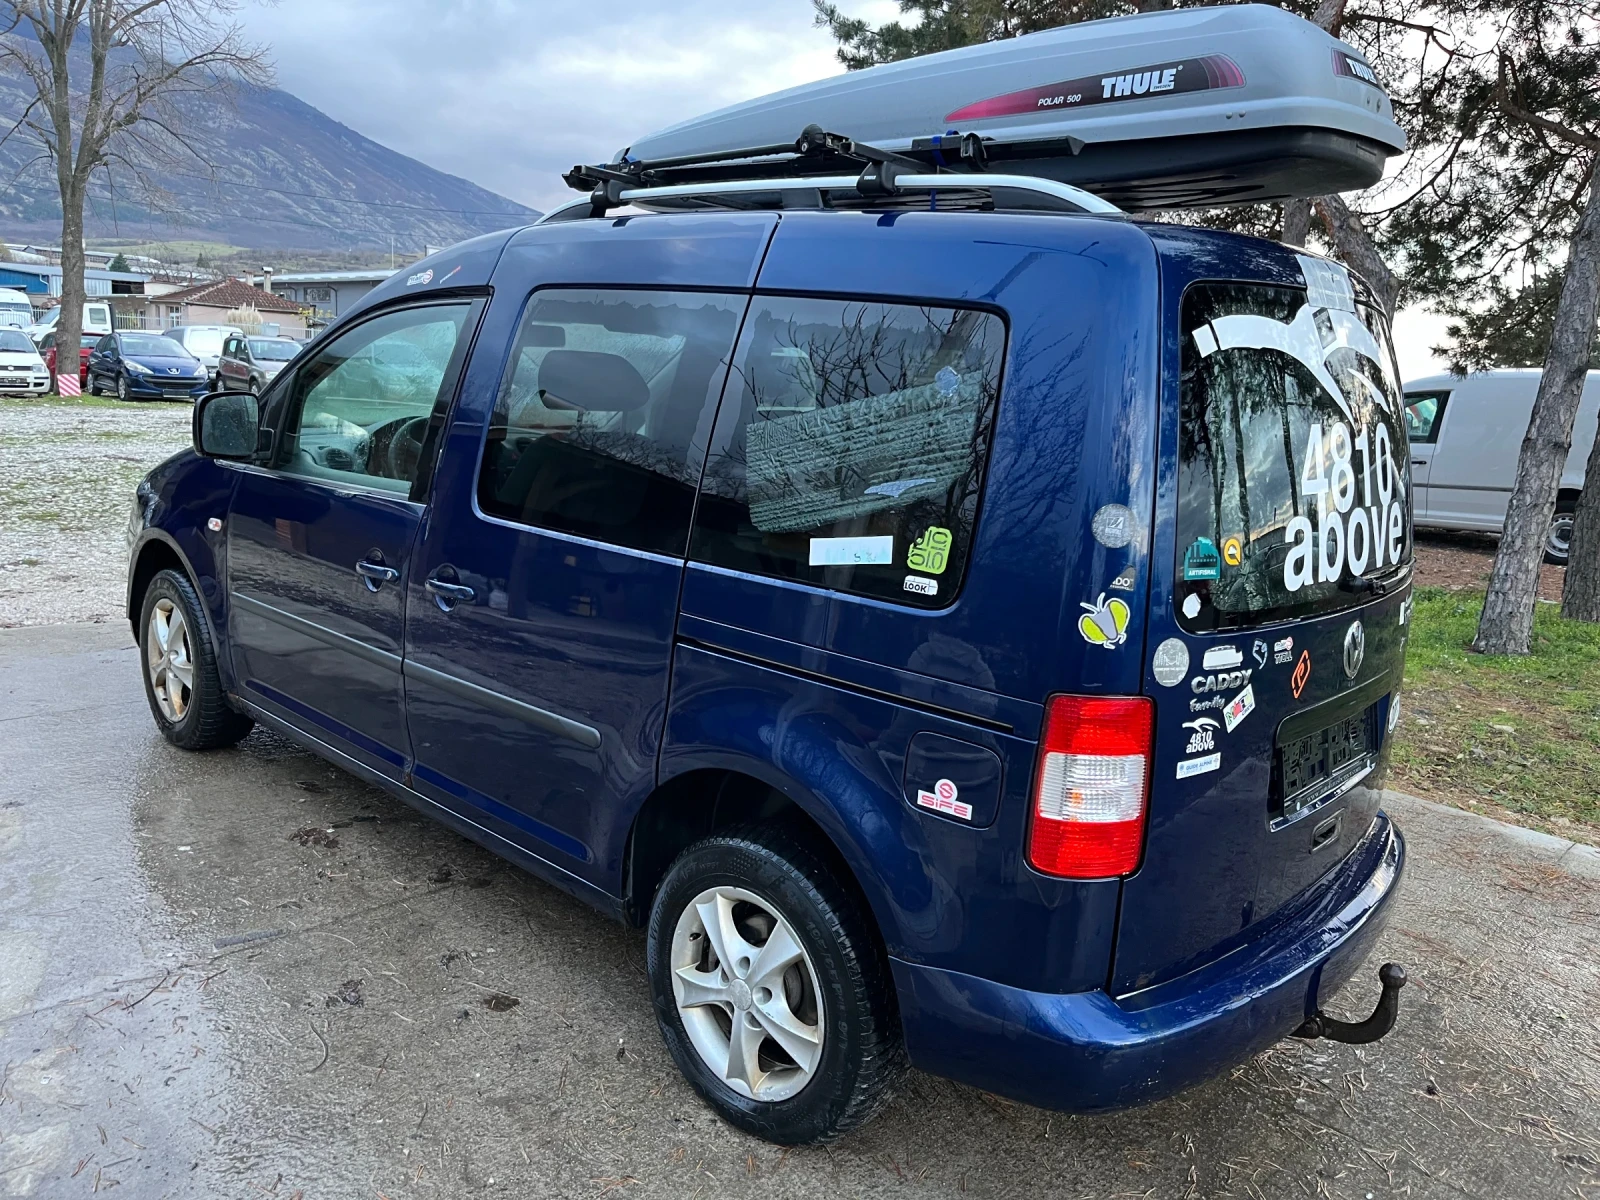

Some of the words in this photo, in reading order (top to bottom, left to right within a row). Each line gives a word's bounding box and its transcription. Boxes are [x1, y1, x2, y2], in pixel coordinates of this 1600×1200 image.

[1101, 68, 1177, 99] THULE
[1037, 95, 1064, 107] POLAR
[1066, 94, 1082, 104] 500
[1301, 421, 1393, 514] 4810
[1283, 496, 1403, 592] above
[904, 582, 928, 593] LOOK
[1190, 668, 1253, 694] CADDY
[1186, 740, 1215, 754] above
[1190, 731, 1213, 744] 4810
